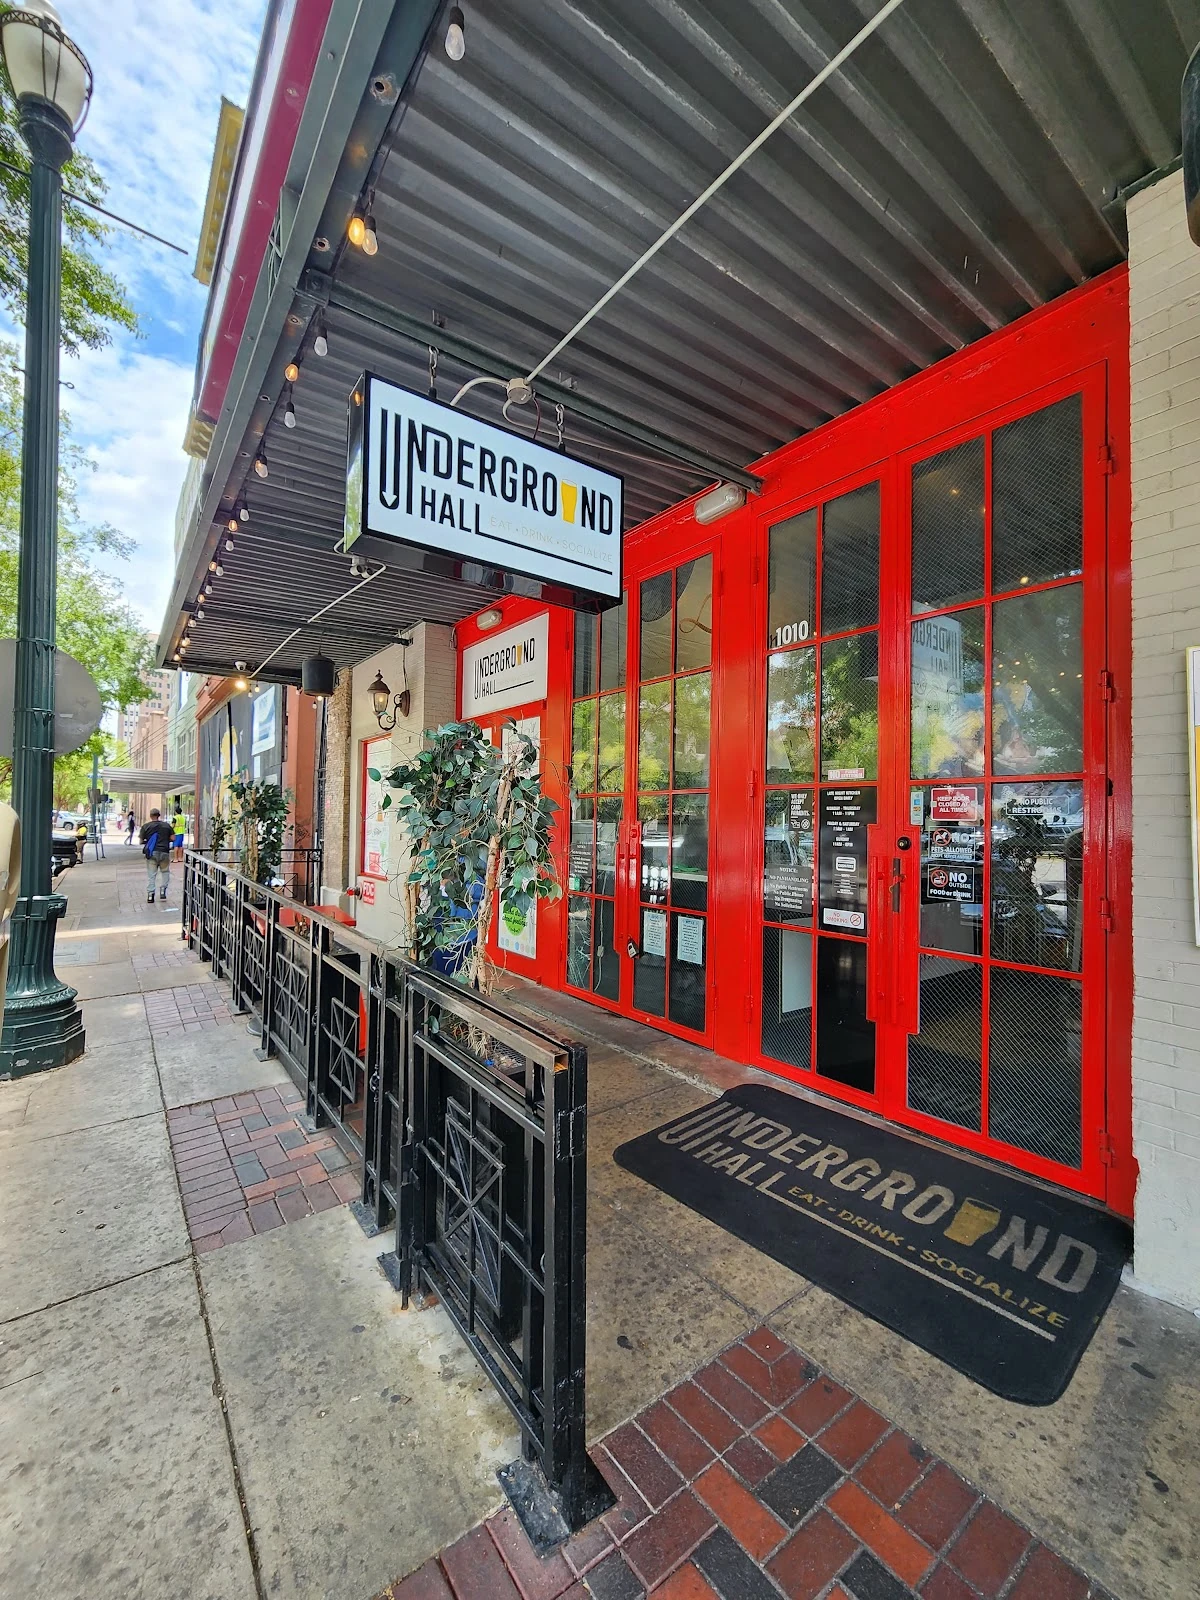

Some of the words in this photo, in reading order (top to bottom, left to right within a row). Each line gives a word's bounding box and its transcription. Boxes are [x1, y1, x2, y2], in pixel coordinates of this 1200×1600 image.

[379, 407, 613, 535] UNDERGROND
[420, 485, 487, 536] HALL
[490, 516, 512, 531] EAT
[521, 526, 554, 545] DRINK
[562, 539, 613, 563] SOCIALIZE
[776, 620, 808, 646] 1010
[474, 638, 536, 700] UNDERGROND
[482, 680, 496, 698] HALL
[952, 832, 969, 843] NO
[363, 882, 374, 896] FDC
[950, 872, 967, 883] NO
[693, 1141, 787, 1198] HALL
[657, 1101, 1098, 1293] UNDERGROND
[788, 1185, 828, 1207] EAT
[836, 1208, 905, 1246] DRINK
[920, 1249, 1071, 1329] SOCIALIZE
